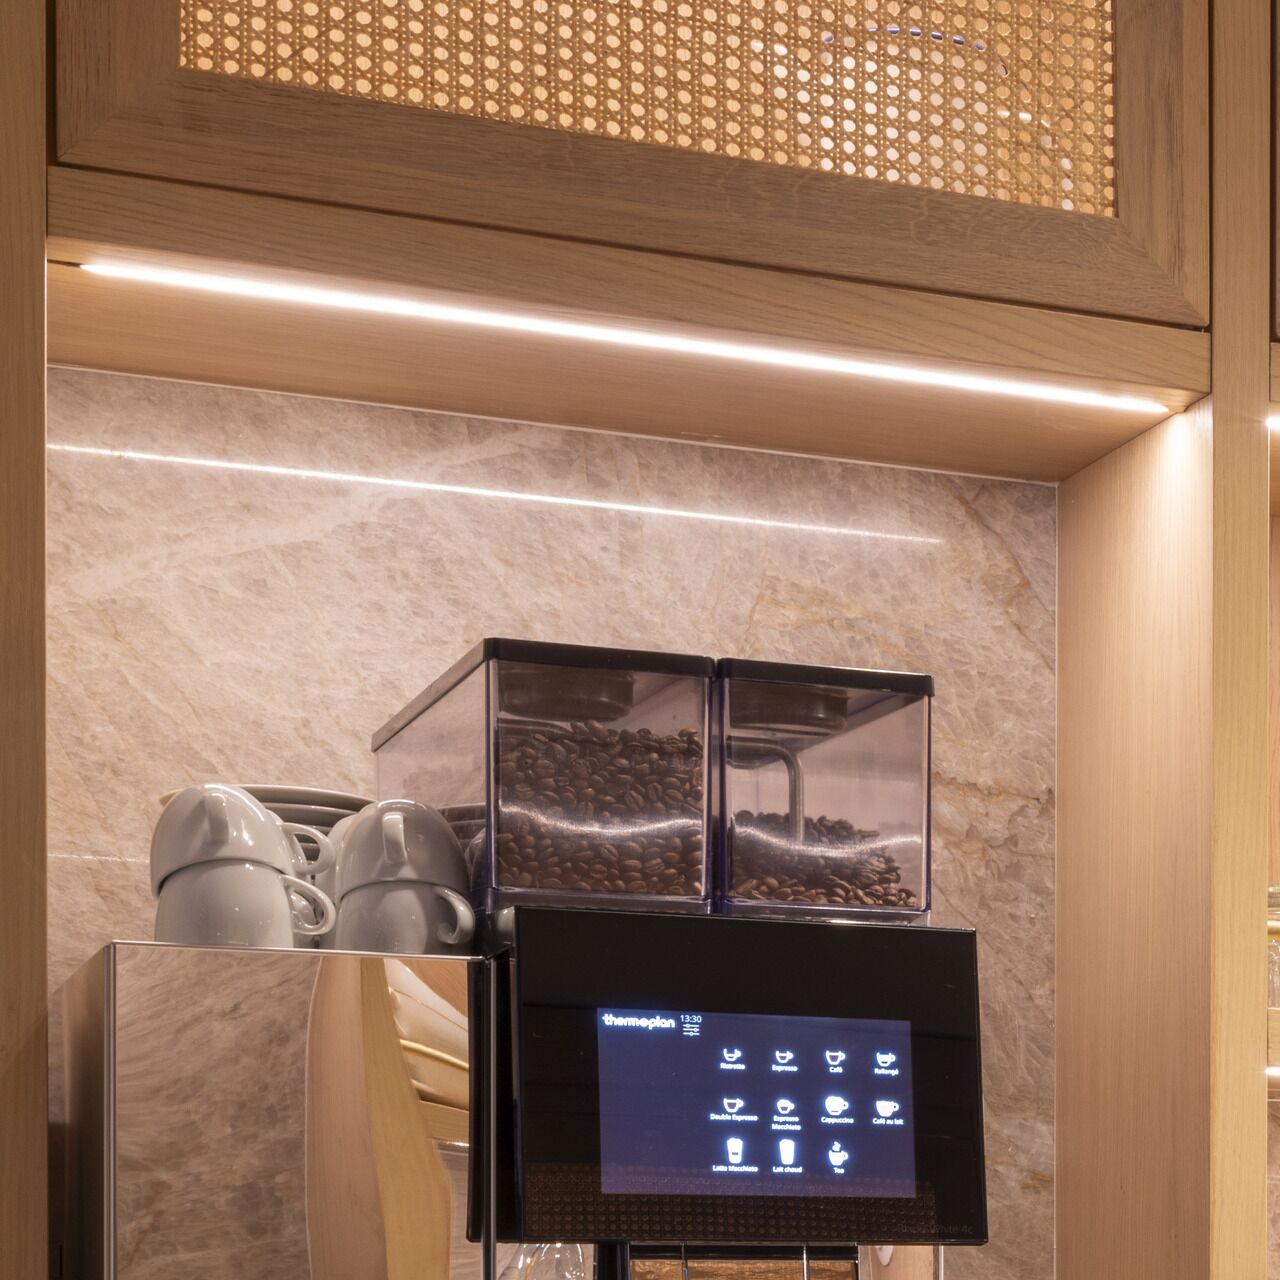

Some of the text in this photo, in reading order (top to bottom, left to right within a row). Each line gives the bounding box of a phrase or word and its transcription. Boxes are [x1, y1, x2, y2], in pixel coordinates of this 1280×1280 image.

[602, 1013, 676, 1031] thermoplan
[680, 1014, 703, 1023] 13:30
[771, 1064, 799, 1073] Espresso
[828, 1066, 844, 1074] Café
[709, 1113, 758, 1122] Double Espresso
[773, 1115, 800, 1123] Espresso
[820, 1116, 855, 1125] Cappuccino
[712, 1164, 728, 1172] Latte
